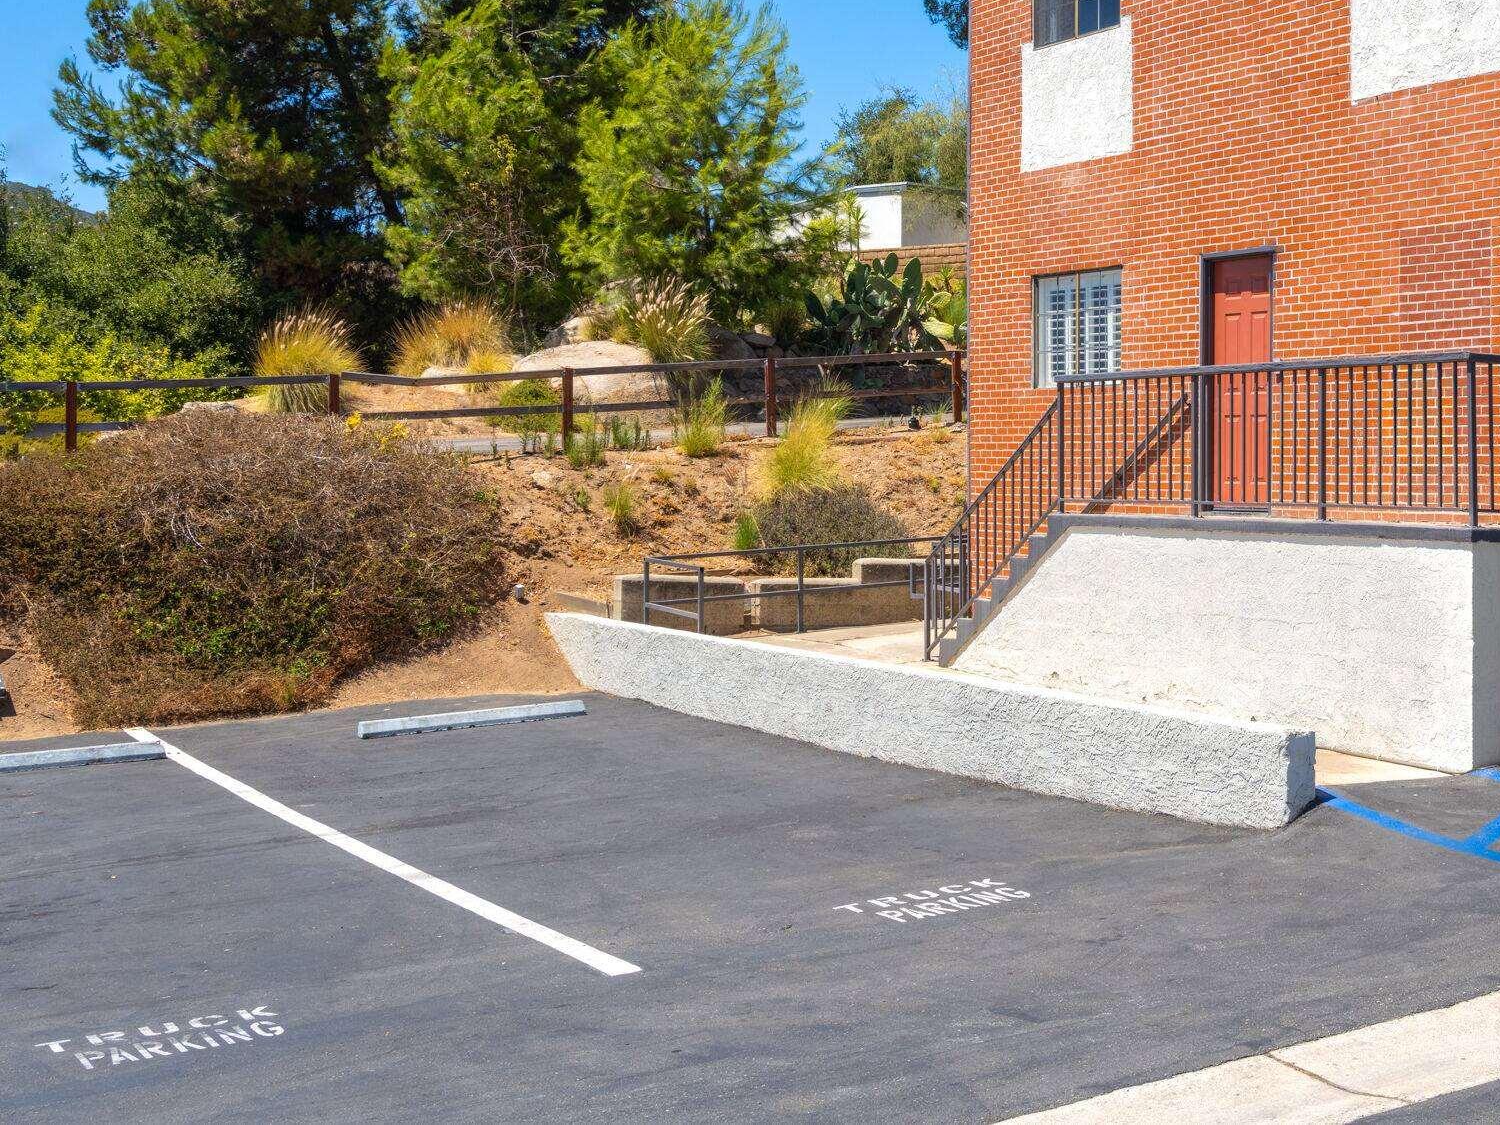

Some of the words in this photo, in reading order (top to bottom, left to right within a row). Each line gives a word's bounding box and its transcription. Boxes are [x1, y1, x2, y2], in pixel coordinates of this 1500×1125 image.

[832, 878, 1006, 913] TRUCK
[875, 887, 1031, 923] PARKING
[34, 1006, 278, 1053] TRUCK
[74, 1021, 284, 1070] PARKING
